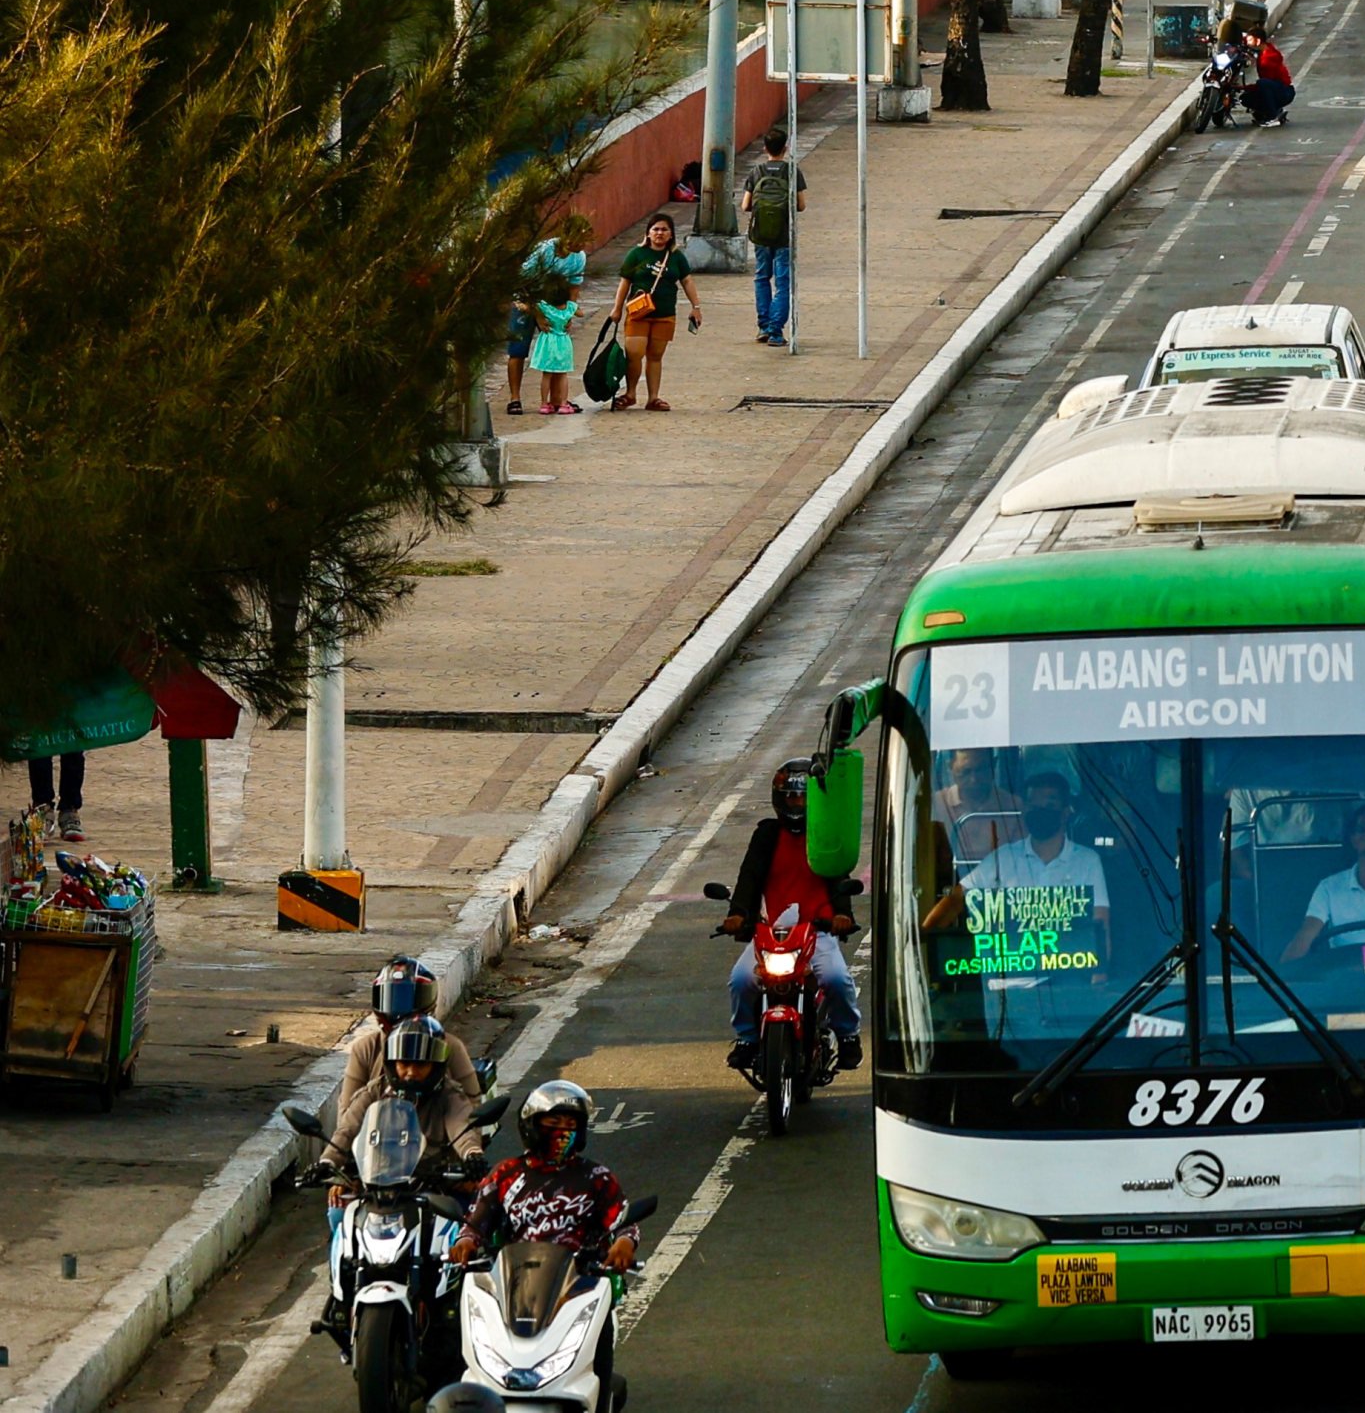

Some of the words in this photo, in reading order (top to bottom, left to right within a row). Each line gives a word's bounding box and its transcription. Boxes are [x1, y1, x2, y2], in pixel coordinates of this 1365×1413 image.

[1185, 352, 1199, 362] UV
[1201, 351, 1236, 362] Express
[1238, 349, 1271, 360] Service
[1033, 647, 1187, 692] ALABANG
[1217, 642, 1354, 686] LAWTON
[943, 671, 998, 721] 23
[1119, 697, 1267, 728] AIRCON
[1006, 886, 1050, 906] SOUTH
[1053, 884, 1091, 905] MALL
[964, 887, 1005, 934] SM
[1010, 899, 1089, 920] MOONWALK
[1016, 916, 1073, 934] ZAPOTE
[974, 930, 1060, 958] PILAR
[945, 954, 1037, 976] CASIMIRO
[1127, 1077, 1266, 1127] 8376
[1226, 1174, 1281, 1189] DRAGON
[1101, 1223, 1189, 1237] GOLDEN
[1214, 1219, 1303, 1234] DRAGON
[1055, 1257, 1099, 1274] ALABANG
[1040, 1273, 1071, 1289] PLAZA
[1074, 1272, 1114, 1289] LAWTON
[1049, 1289, 1071, 1305] VICE
[1075, 1287, 1107, 1304] VERSA
[1155, 1314, 1191, 1336] NAC
[1203, 1313, 1252, 1334] 9965
